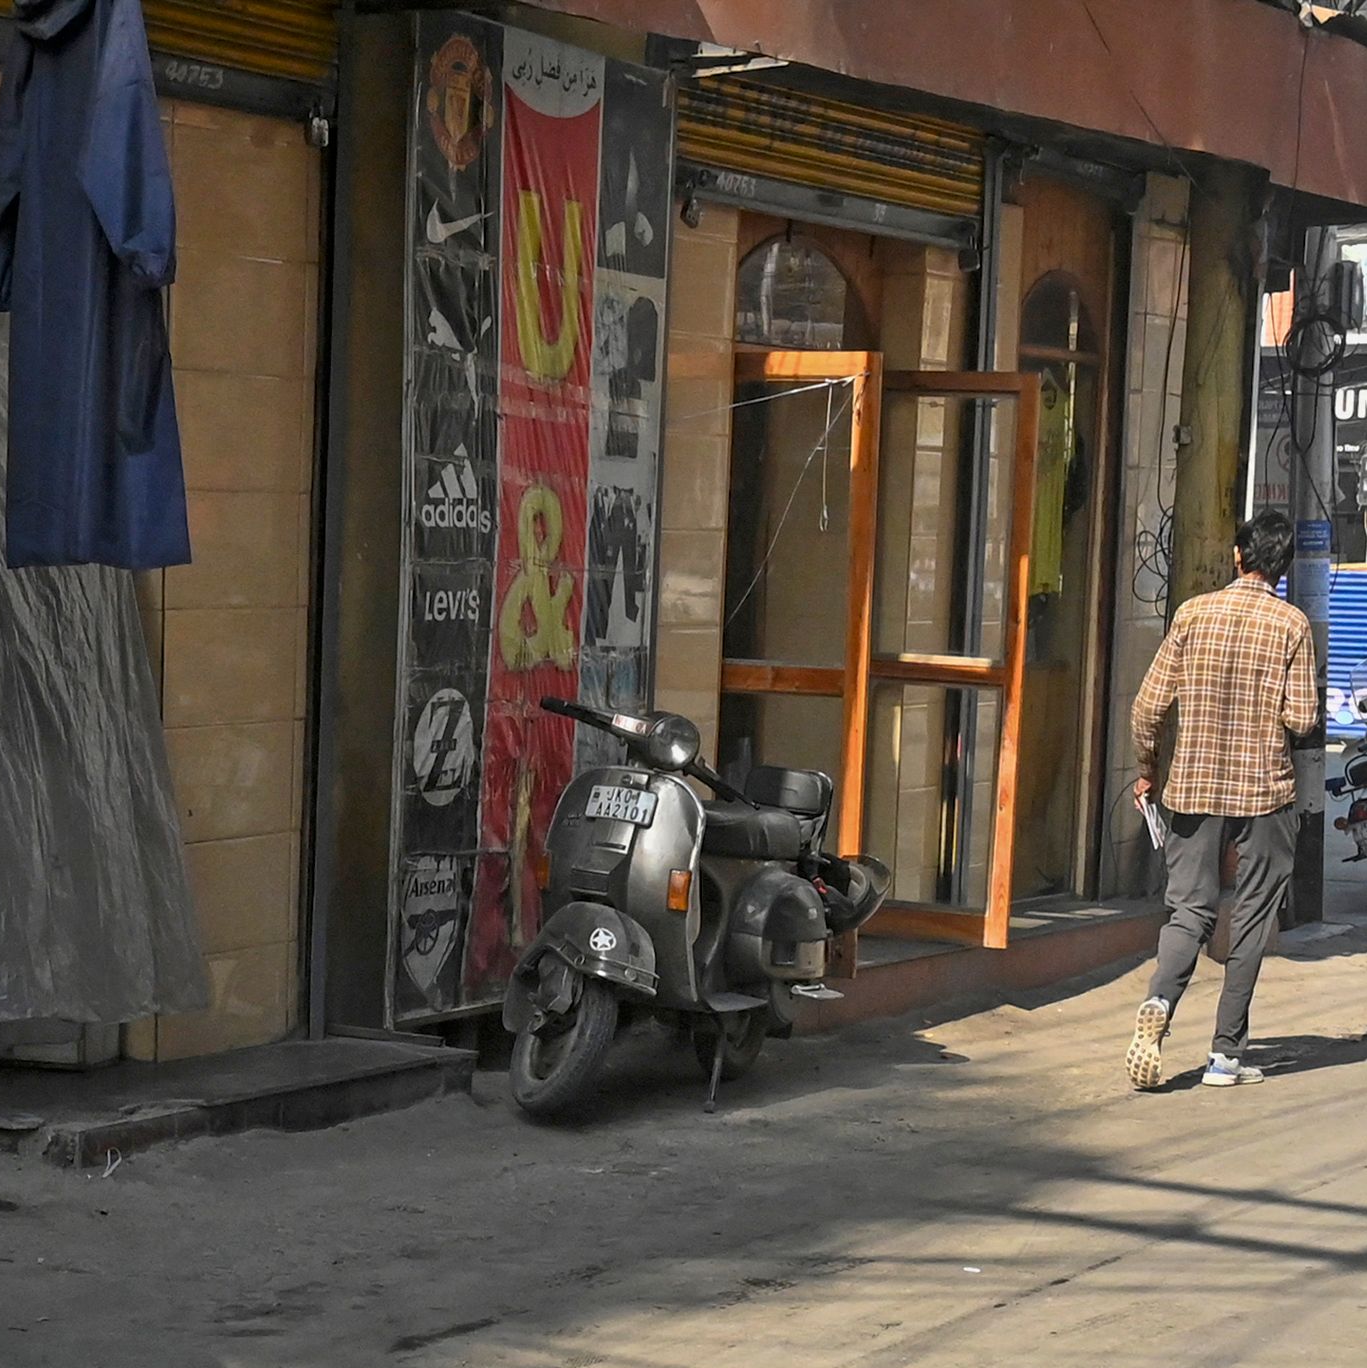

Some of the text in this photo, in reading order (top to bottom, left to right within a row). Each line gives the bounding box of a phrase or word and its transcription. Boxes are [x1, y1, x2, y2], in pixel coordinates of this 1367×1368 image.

[516, 190, 583, 384] U
[422, 497, 492, 534] adidas
[607, 788, 642, 805] JK01
[596, 802, 649, 823] AA2101
